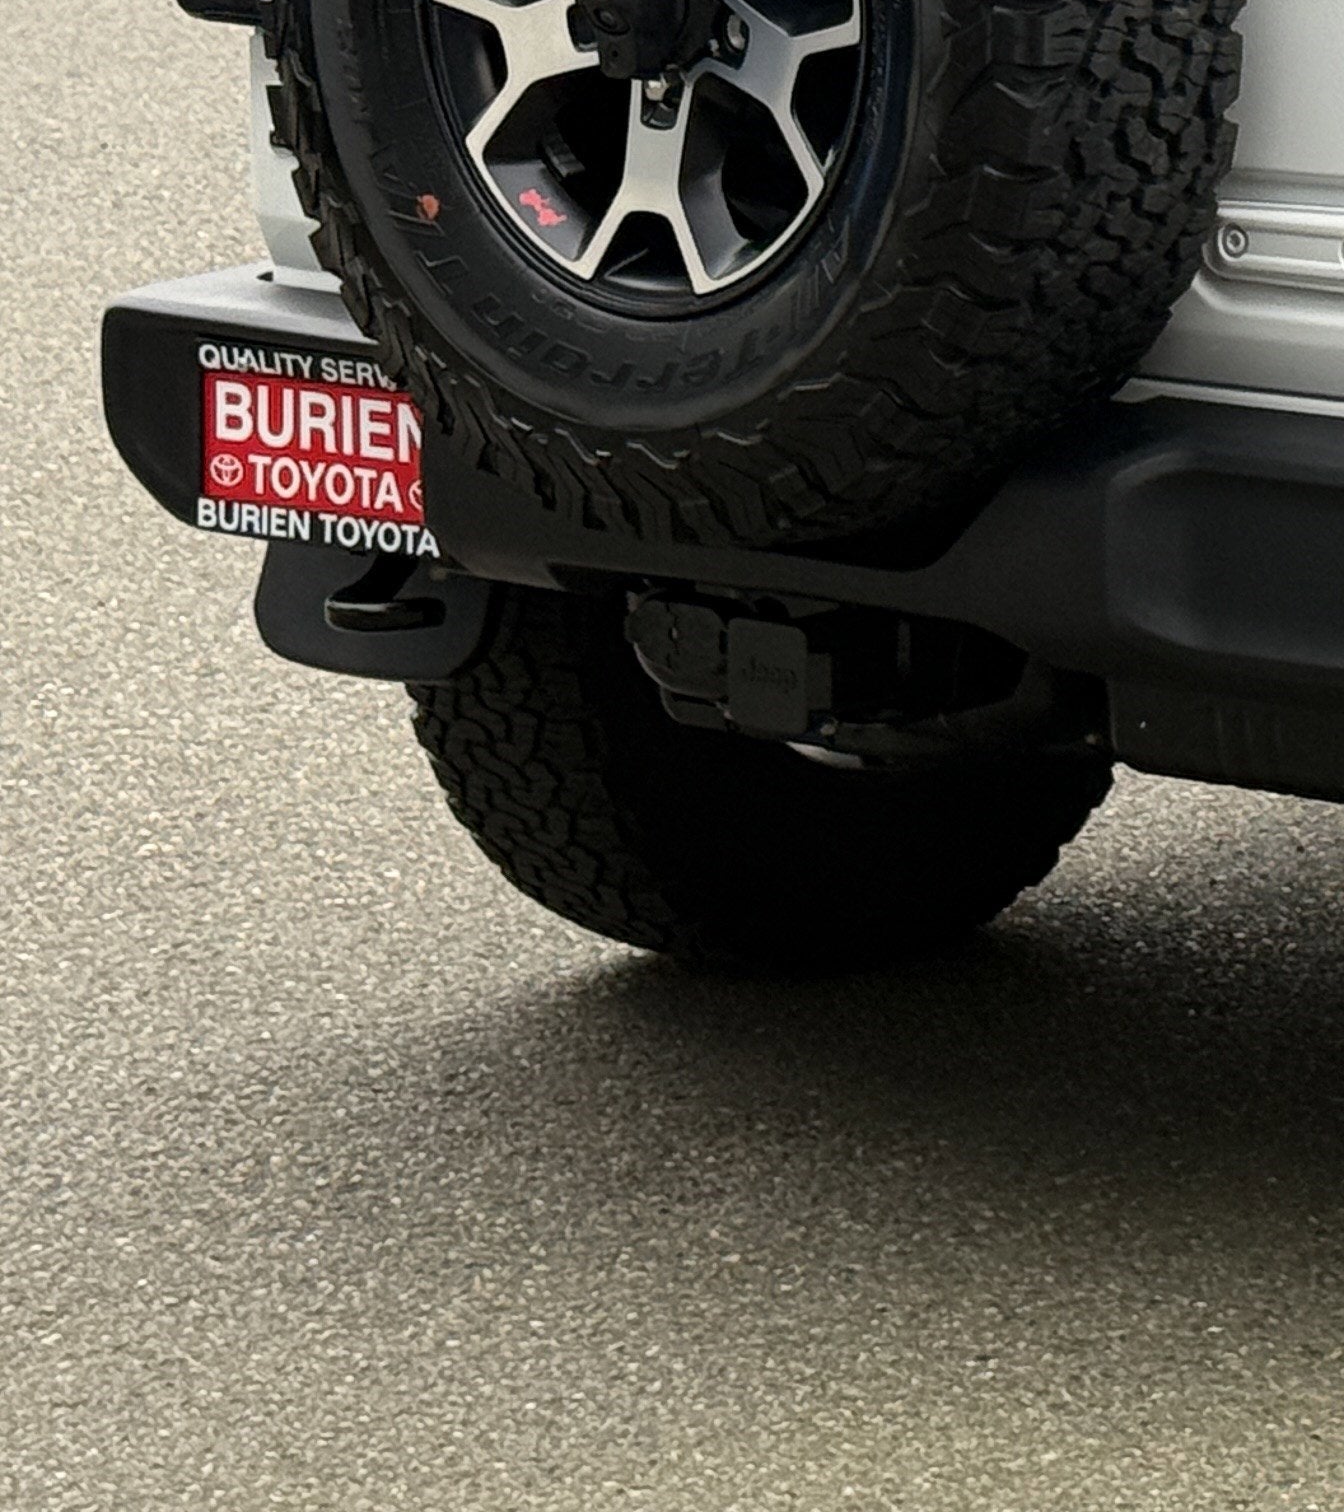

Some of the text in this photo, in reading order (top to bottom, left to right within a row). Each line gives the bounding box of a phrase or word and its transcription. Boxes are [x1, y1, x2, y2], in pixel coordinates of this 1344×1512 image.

[198, 344, 313, 379] QUALITY
[247, 454, 405, 514] TOYOTA
[197, 498, 441, 559] BURIEN TOYOTA
